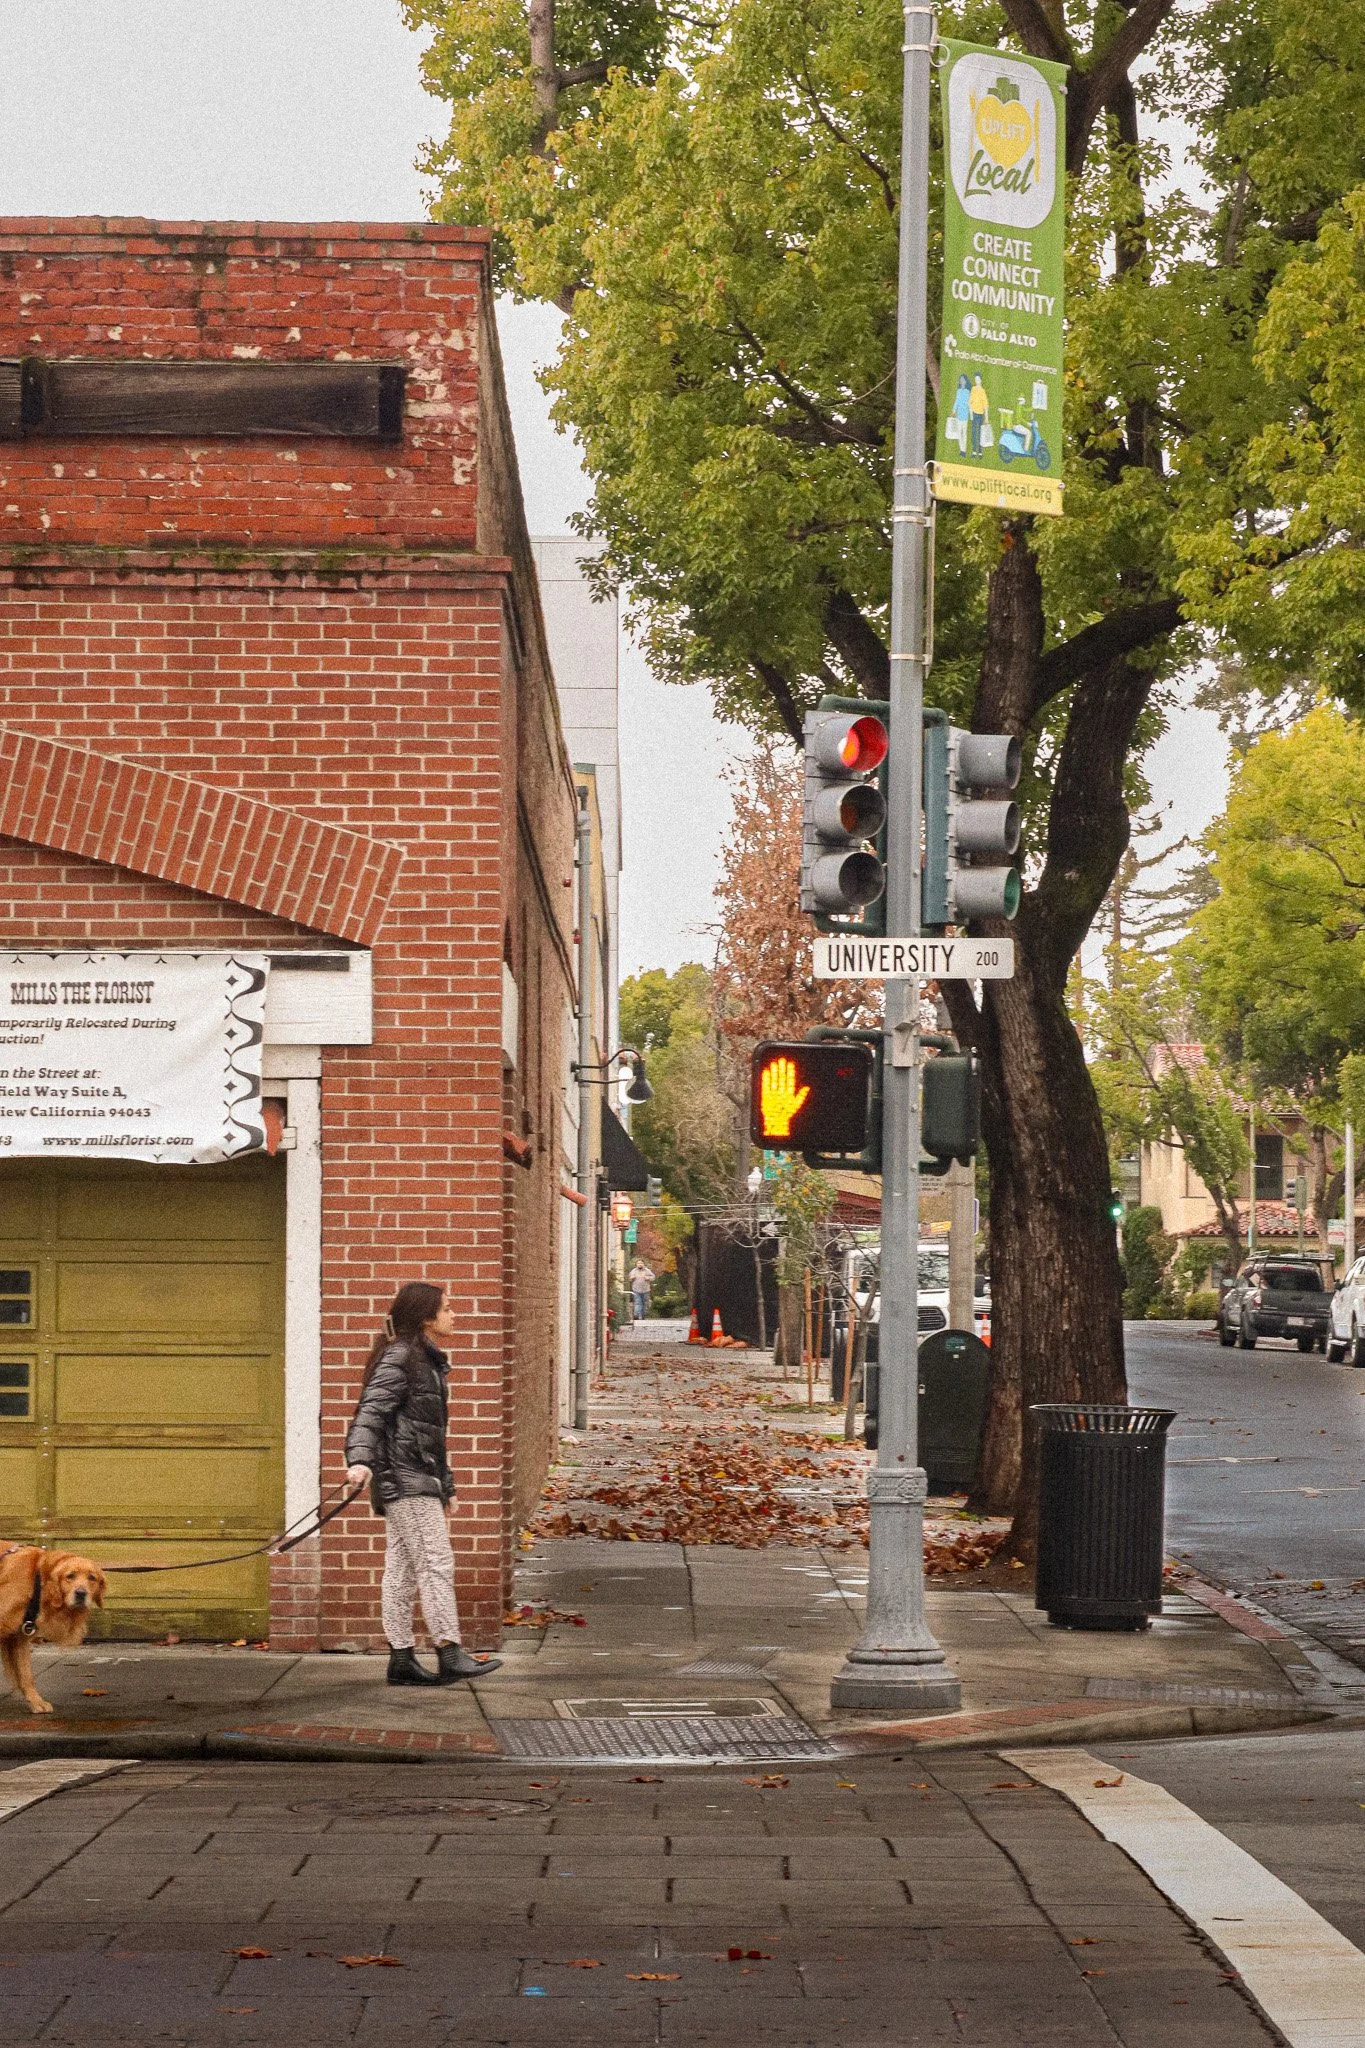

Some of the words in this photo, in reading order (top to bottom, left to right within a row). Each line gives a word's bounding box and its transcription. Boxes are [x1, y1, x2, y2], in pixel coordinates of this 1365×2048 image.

[981, 117, 1026, 141] UPLIFT
[963, 149, 1035, 198] Local
[972, 231, 1033, 262] CREATE
[962, 255, 1042, 289] CONNECT
[951, 278, 1056, 317] COMMUNITY
[980, 327, 1007, 343] PALO
[1009, 333, 1037, 348] ALTO
[942, 475, 1053, 503] www.upliftlocal.org
[828, 944, 955, 973] UNIVERSITY
[975, 951, 999, 966] 200
[10, 981, 58, 1005] MILLS
[60, 981, 92, 1005] THE
[94, 981, 155, 1005] FLORIST
[65, 1017, 128, 1029] Relocated
[131, 1018, 177, 1031] During
[13, 1066, 36, 1079] the
[38, 1067, 80, 1079] Street
[34, 1086, 68, 1099] Way
[71, 1086, 110, 1097] Suite
[112, 1086, 128, 1099] A,
[30, 1106, 106, 1117] California
[109, 1107, 151, 1117] 94043
[42, 1135, 194, 1146] www.millsflorist.com
